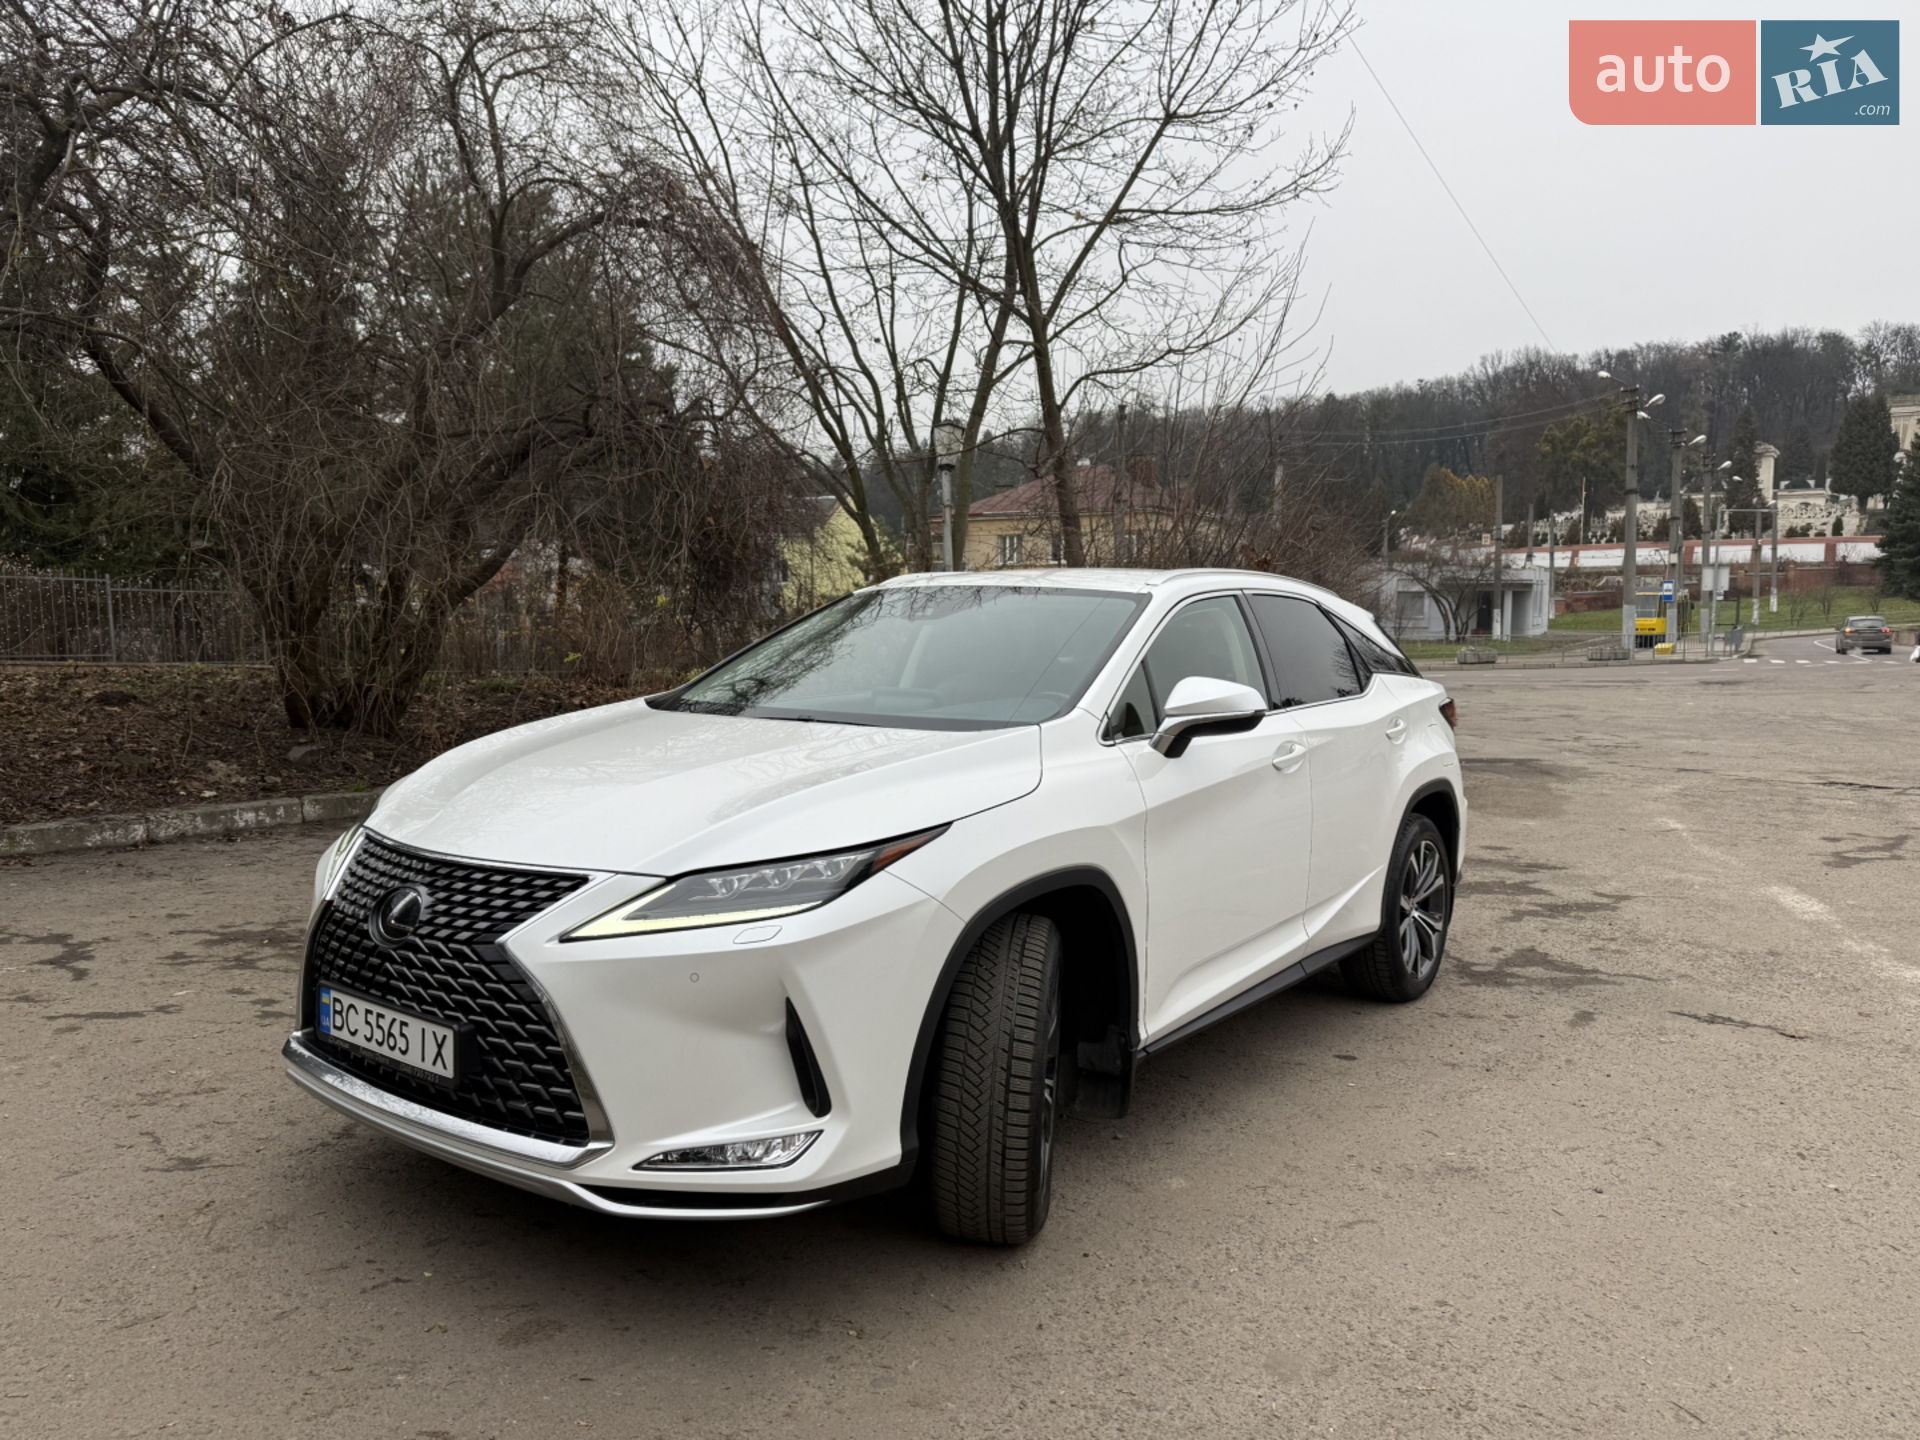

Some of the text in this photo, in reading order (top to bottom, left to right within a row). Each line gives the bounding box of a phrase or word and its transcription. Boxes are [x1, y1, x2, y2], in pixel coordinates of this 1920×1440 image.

[332, 997, 359, 1037] BC
[363, 1007, 410, 1056] 5565
[421, 1027, 448, 1071] IX
